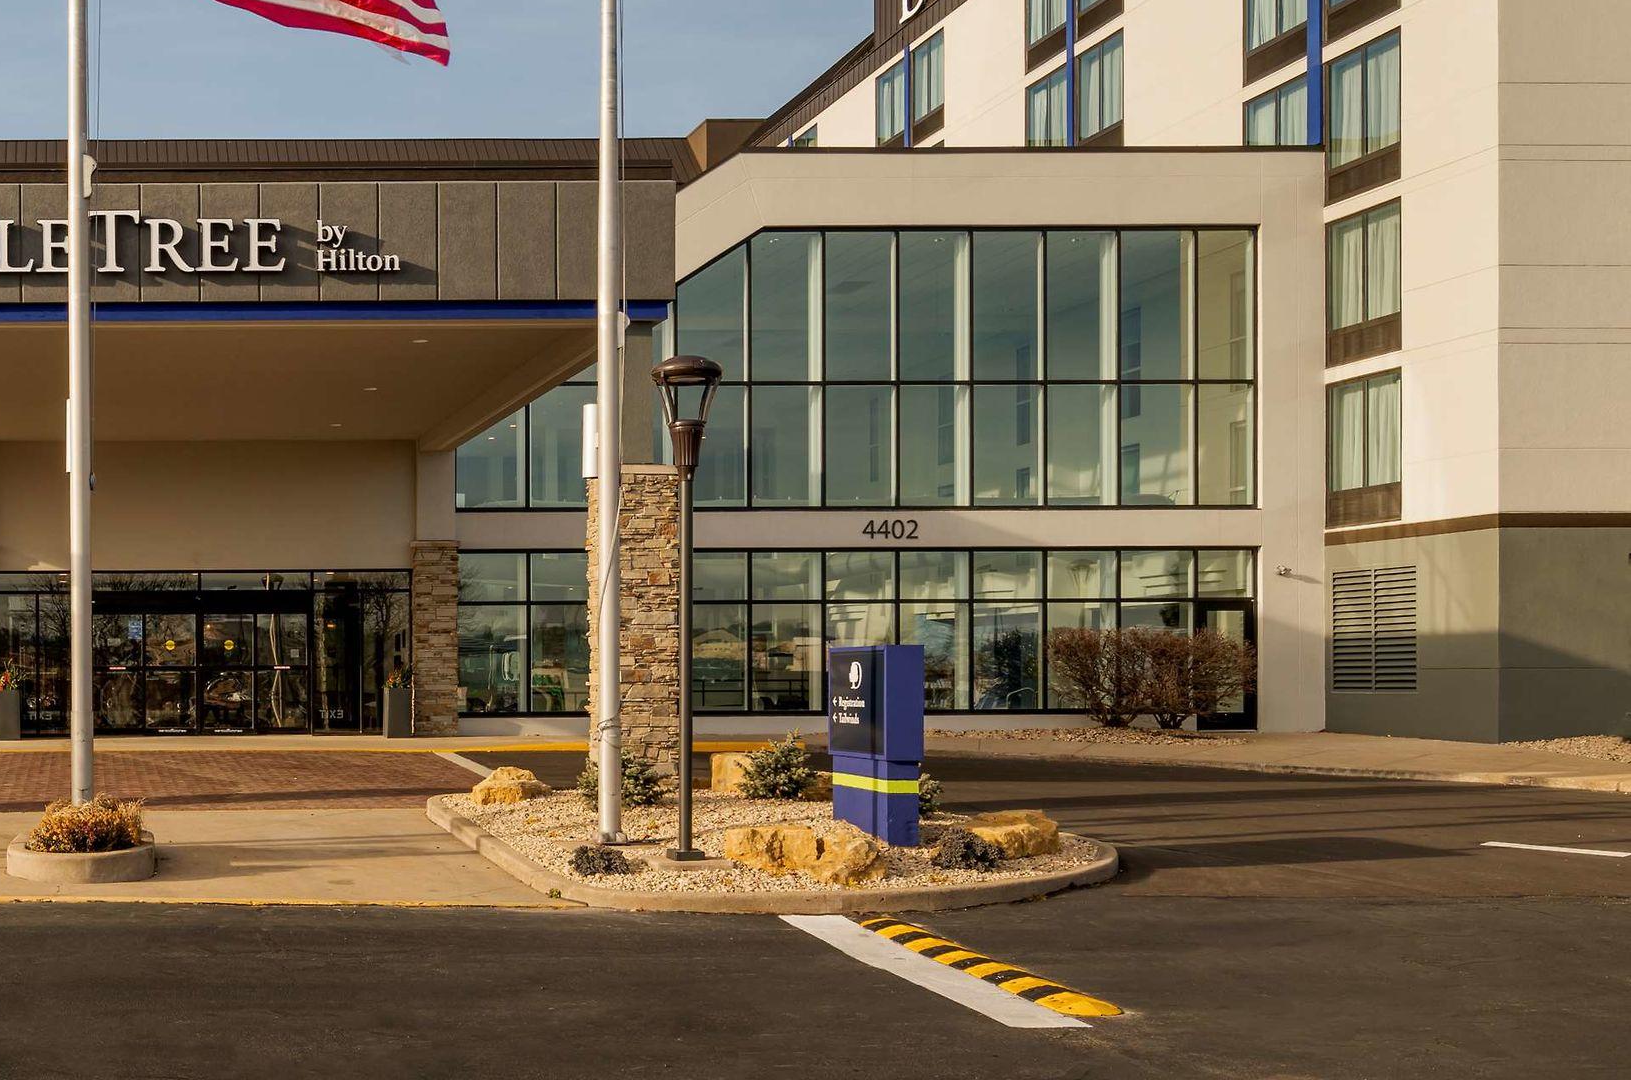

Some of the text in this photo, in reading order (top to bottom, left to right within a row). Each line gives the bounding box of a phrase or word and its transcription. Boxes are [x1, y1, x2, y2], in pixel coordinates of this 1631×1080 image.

[316, 219, 348, 247] by
[315, 248, 401, 273] Hilton
[862, 519, 919, 539] 4402
